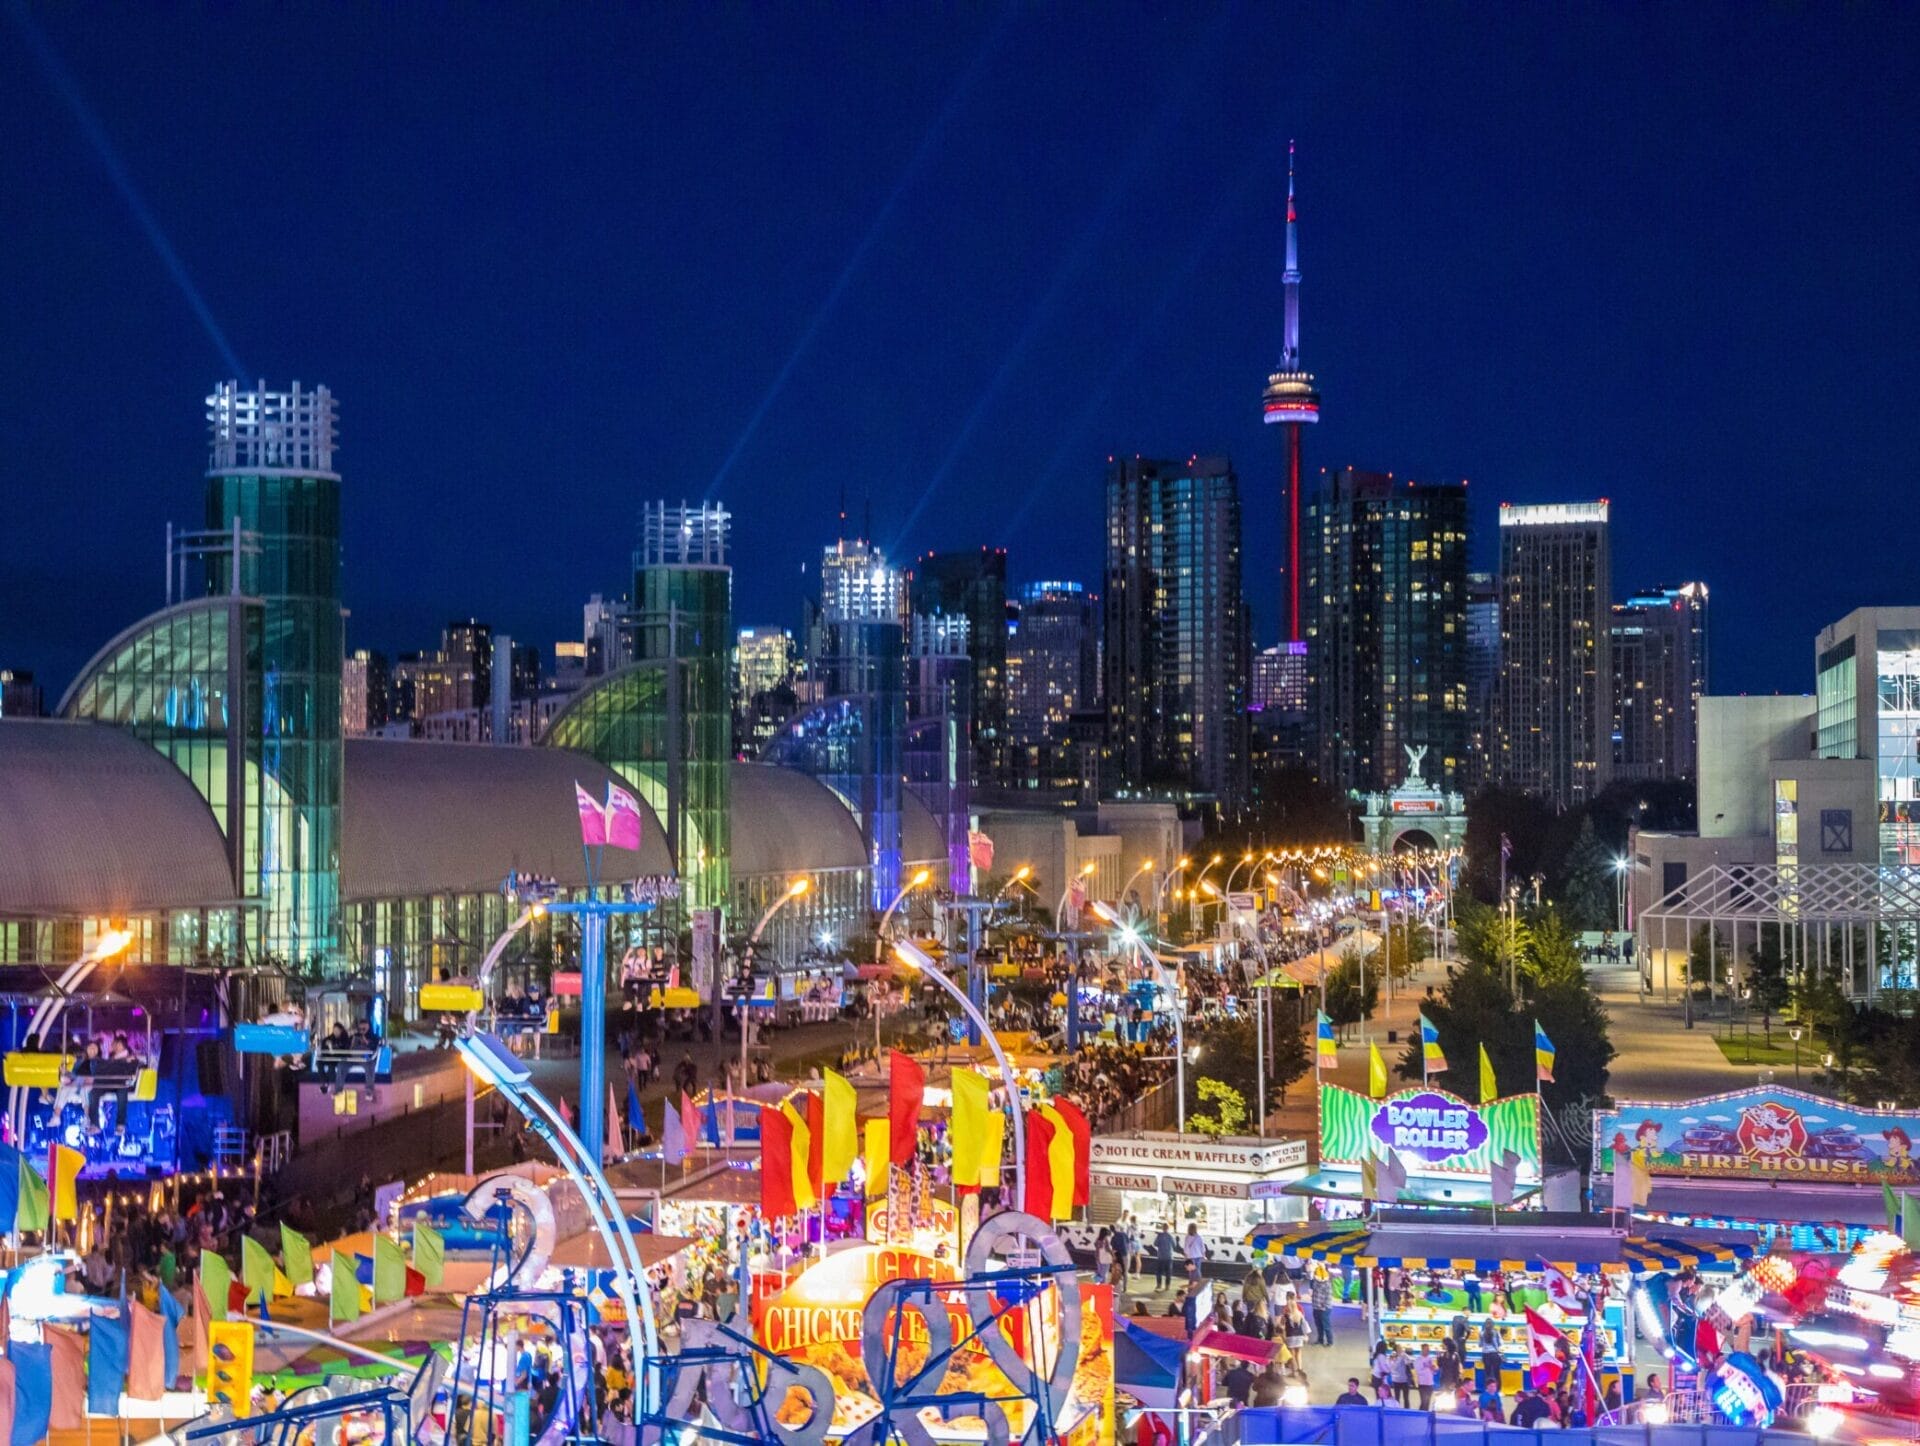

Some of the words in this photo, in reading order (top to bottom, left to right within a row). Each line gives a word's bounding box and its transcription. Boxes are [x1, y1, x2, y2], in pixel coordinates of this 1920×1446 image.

[1388, 1106, 1470, 1130] BOWLER
[1394, 1127, 1470, 1151] ROLLER
[1106, 1146, 1127, 1157] HOT
[1131, 1147, 1149, 1158] ICE
[1153, 1149, 1191, 1161] CREAM
[1195, 1151, 1247, 1164] WAFFLES
[1682, 1153, 1750, 1169] FIRE
[1761, 1156, 1869, 1175] HOUSE
[1106, 1175, 1151, 1189] CREAM
[1173, 1180, 1238, 1196] WAFFLES
[764, 1305, 863, 1353] CHICKE
